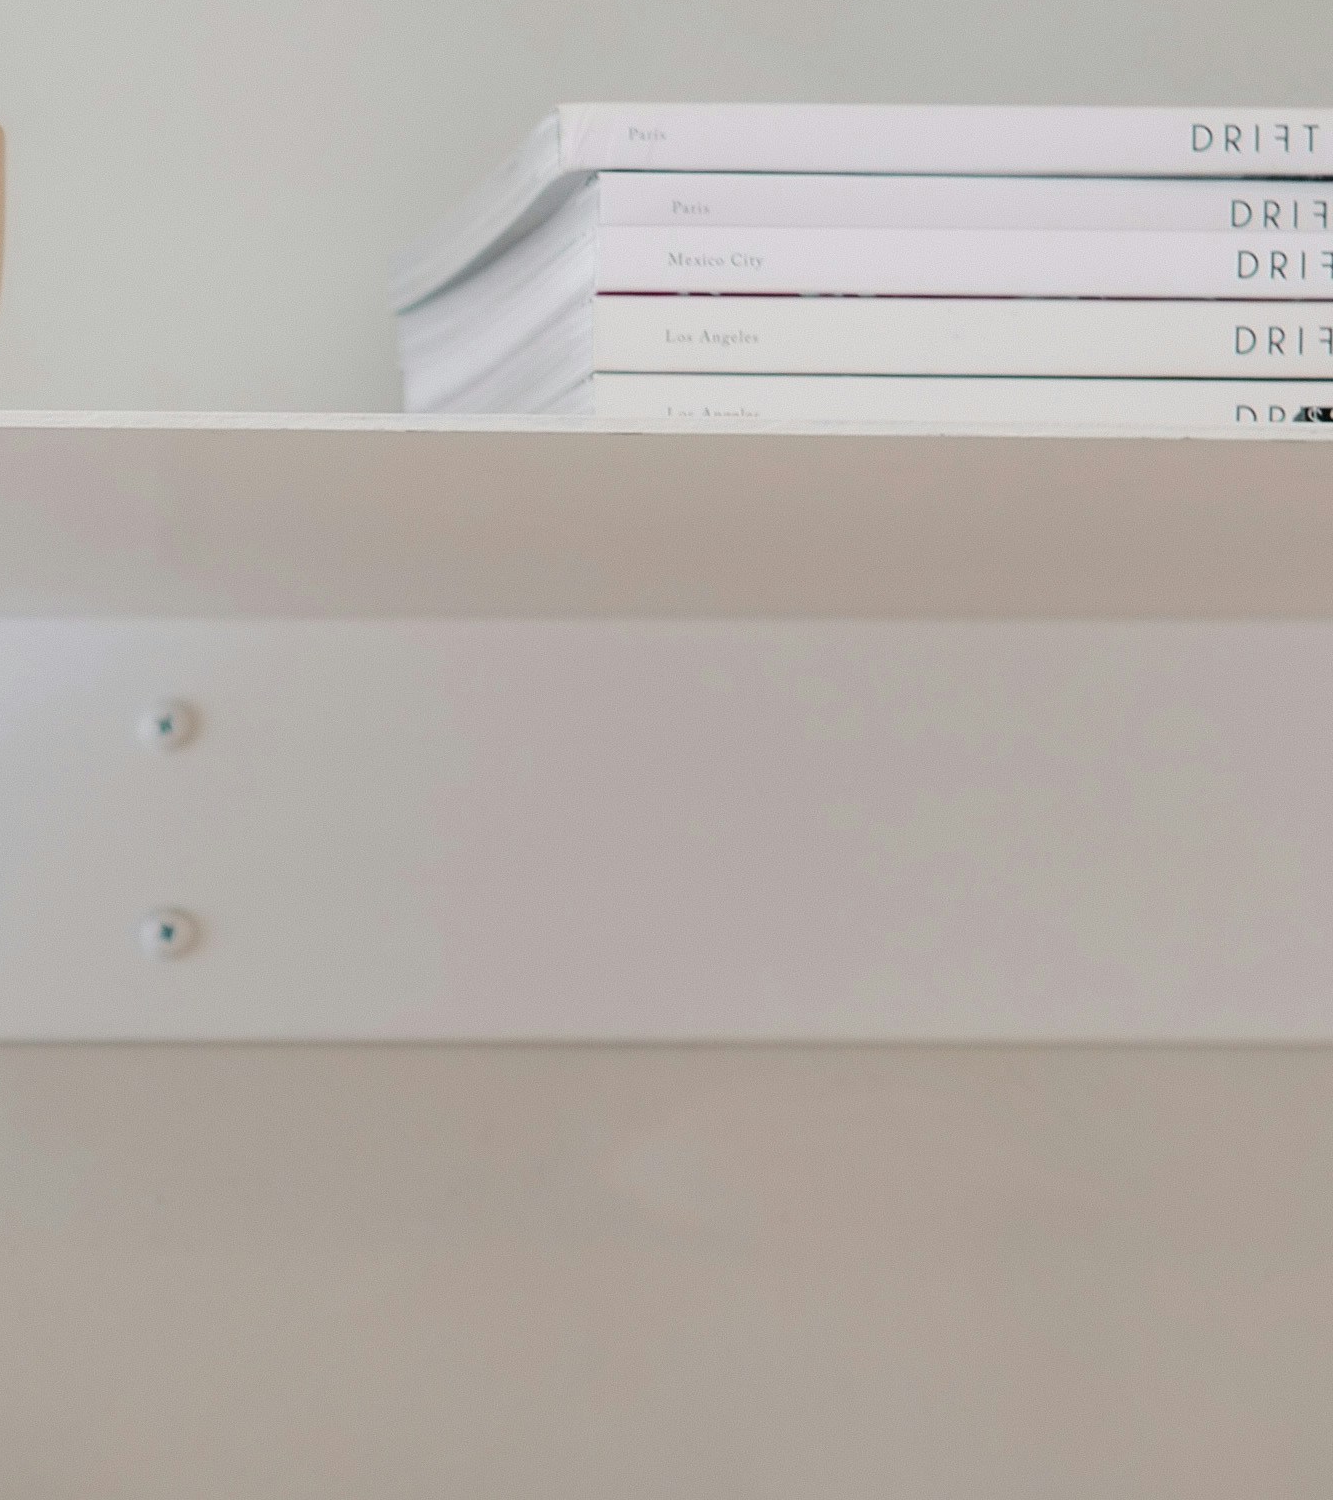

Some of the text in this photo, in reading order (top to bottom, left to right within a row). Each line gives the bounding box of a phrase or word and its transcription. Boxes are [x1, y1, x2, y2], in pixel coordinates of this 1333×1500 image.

[628, 126, 667, 142] Paris
[1191, 123, 1319, 153] DRIFT
[672, 200, 711, 215] Paris
[668, 252, 763, 268] Mexico City
[665, 328, 759, 347] Los Angeles
